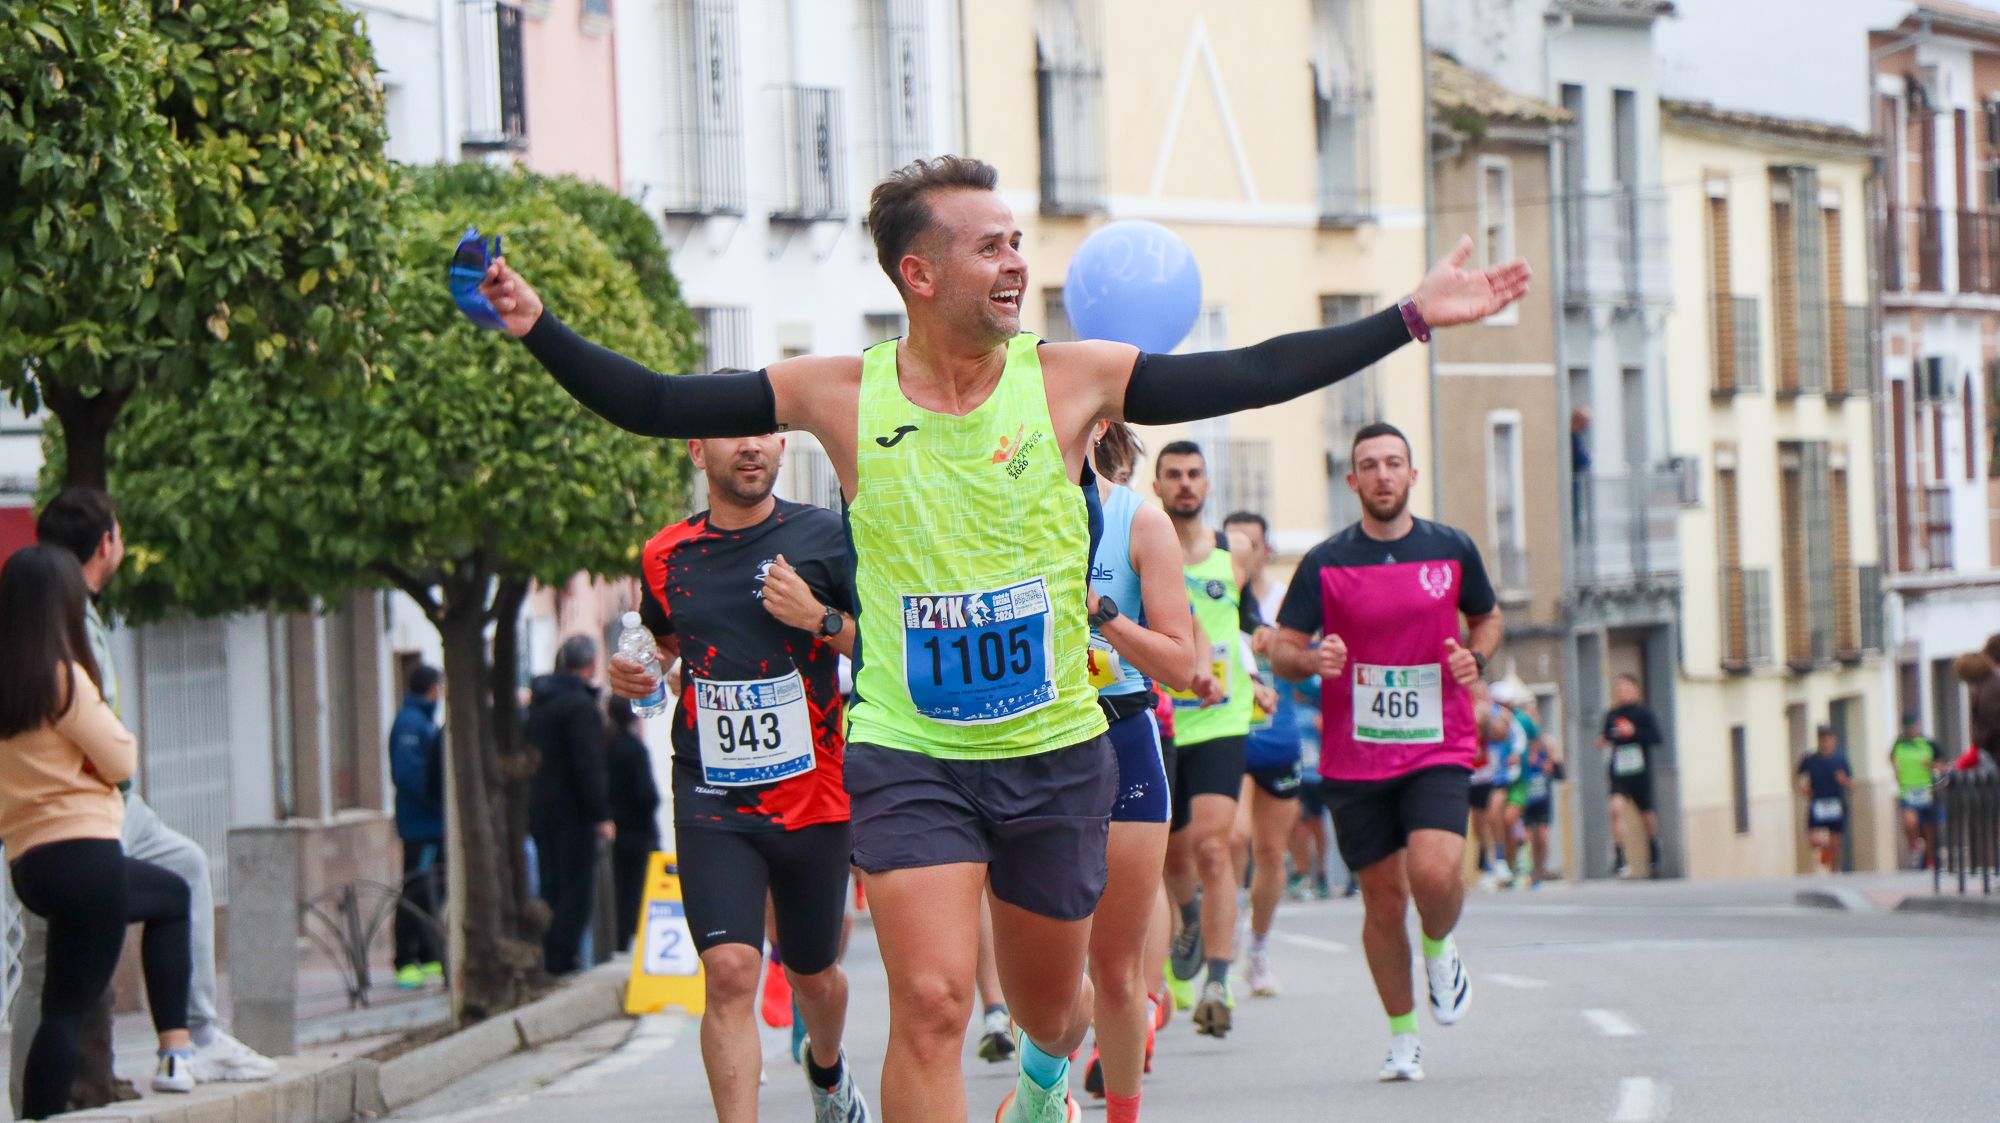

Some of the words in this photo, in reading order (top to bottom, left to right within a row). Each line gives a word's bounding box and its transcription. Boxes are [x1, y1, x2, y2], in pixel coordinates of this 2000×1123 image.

[1005, 457, 1018, 472] NEW
[1016, 443, 1030, 460] YORK
[1028, 429, 1040, 444] CITY
[1007, 432, 1043, 477] MARATHON
[1012, 459, 1030, 480] 2020
[919, 597, 967, 629] 21K
[994, 611, 1014, 622] 2026
[924, 624, 1032, 686] 1105
[706, 684, 740, 710] 21K
[1372, 692, 1419, 718] 466
[717, 712, 782, 754] 943
[660, 930, 681, 959] 2
